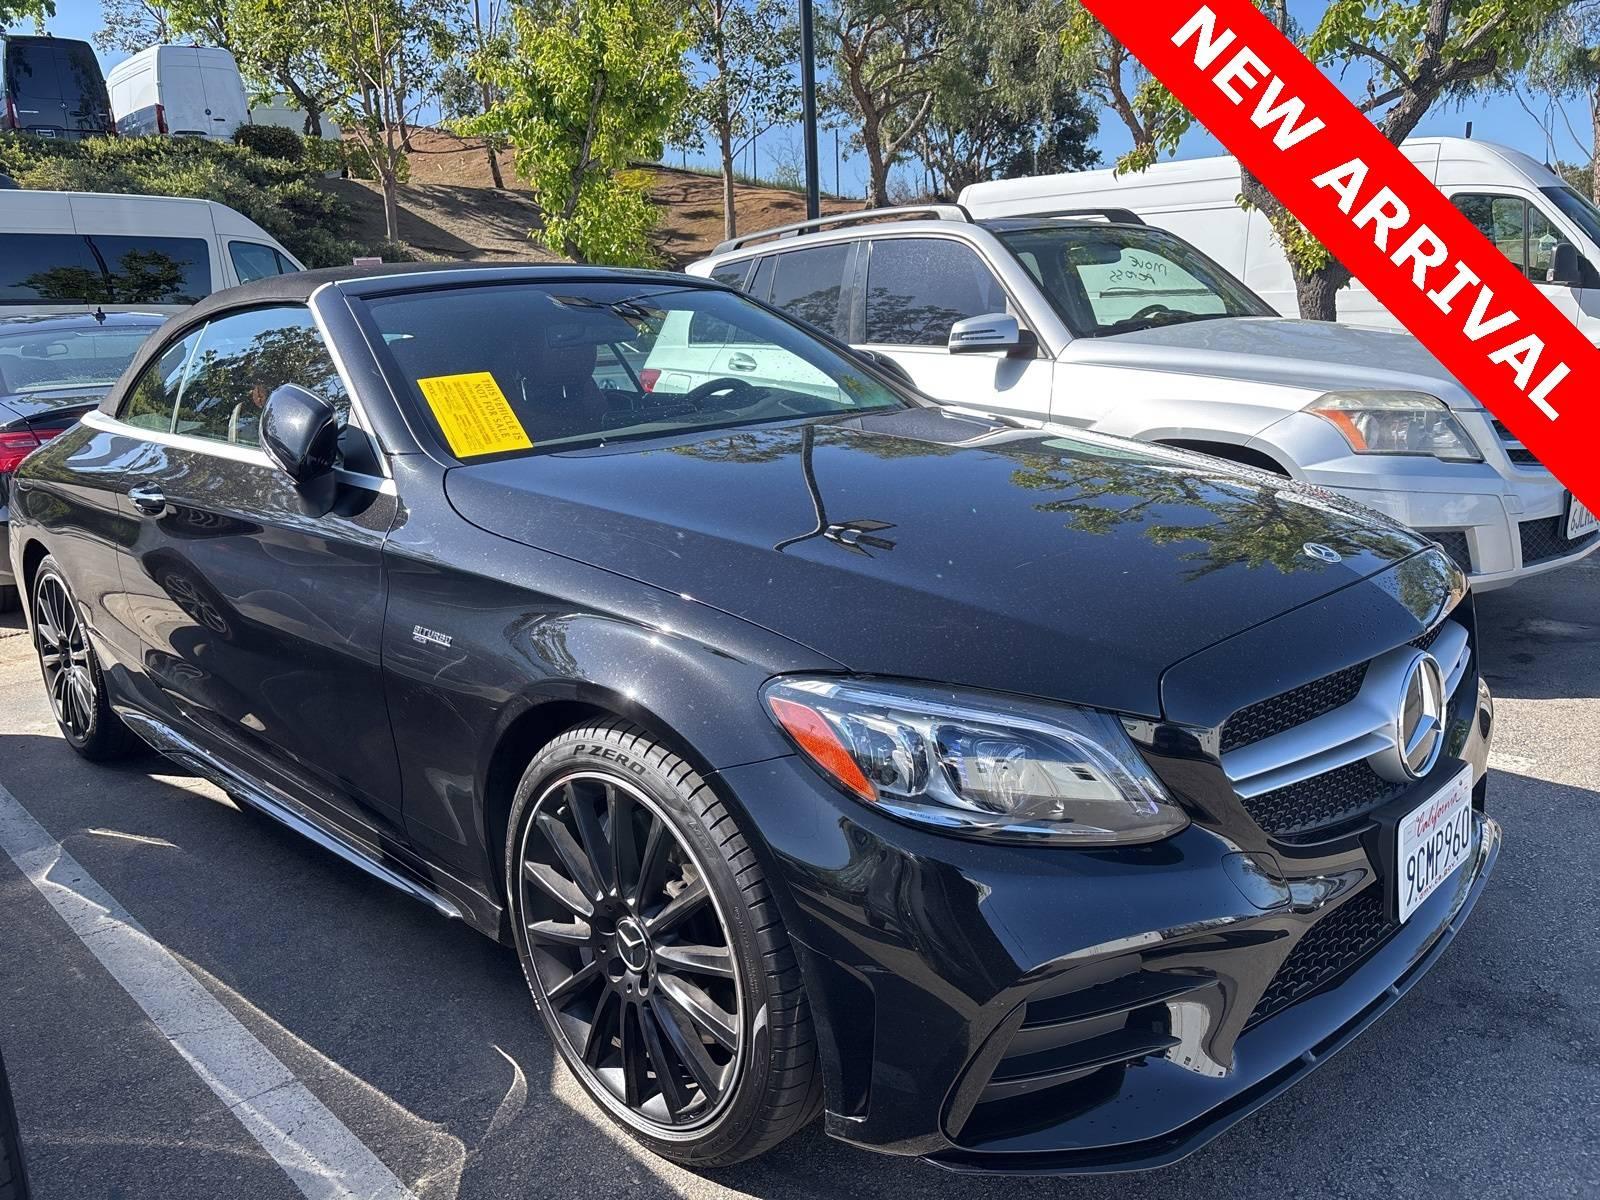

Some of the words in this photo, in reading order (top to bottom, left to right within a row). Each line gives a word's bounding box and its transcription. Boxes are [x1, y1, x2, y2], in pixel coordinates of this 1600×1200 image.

[474, 384, 488, 399] NOT
[483, 400, 497, 417] FOR
[494, 418, 511, 438] SALE
[481, 379, 497, 398] THIS
[494, 396, 518, 432] VEHICLE
[512, 432, 523, 441] IS
[413, 624, 452, 645] BITURBO
[573, 744, 585, 755] P
[588, 745, 646, 775] ZERO
[1415, 792, 1461, 837] California
[1406, 805, 1470, 907] 9CMP960
